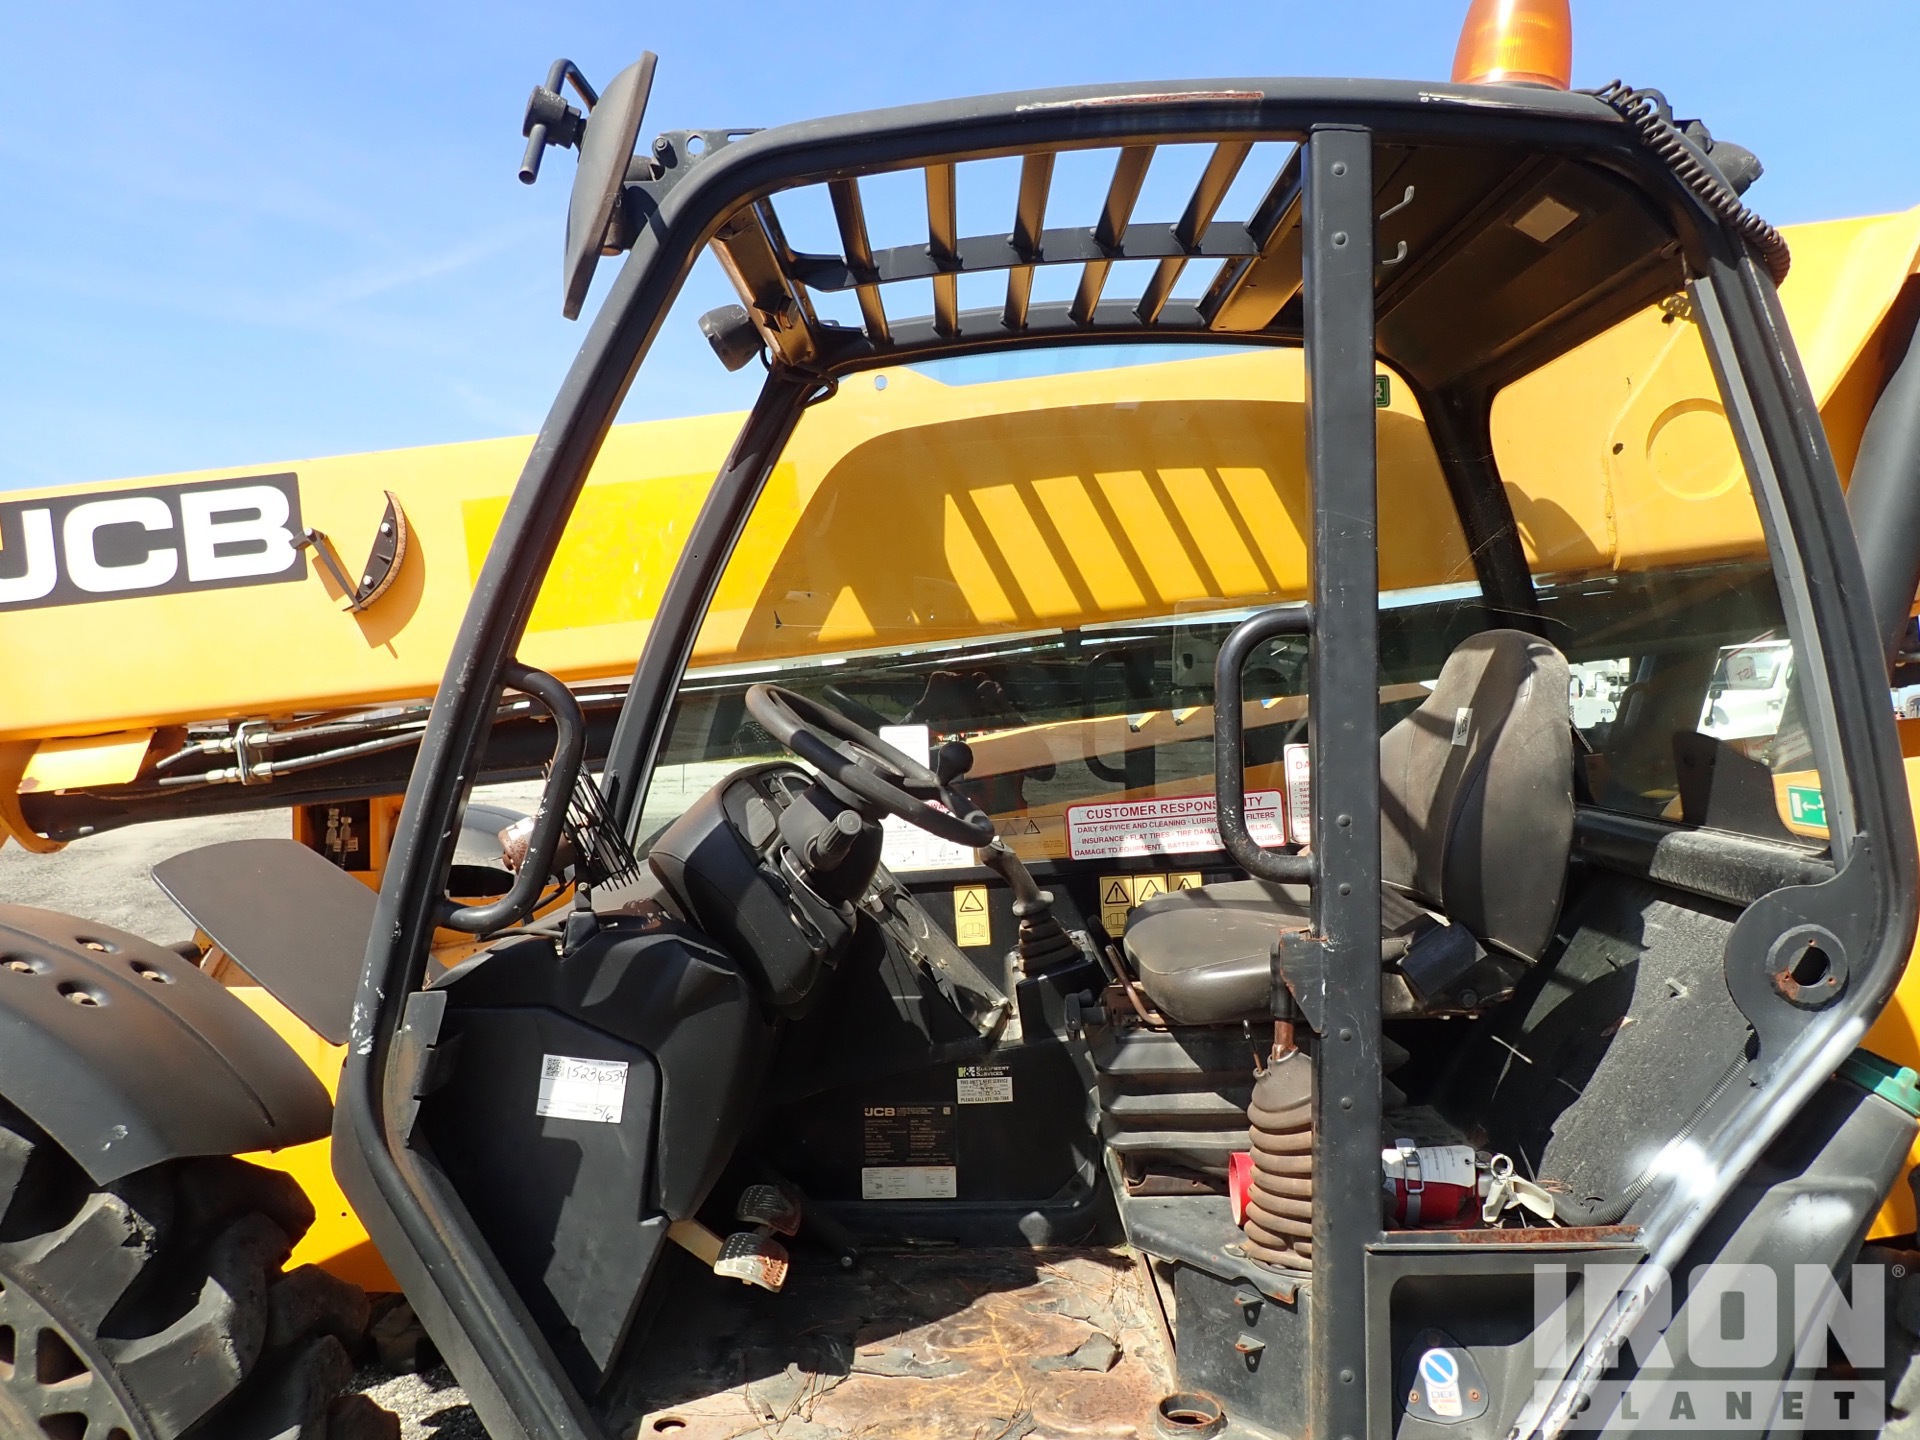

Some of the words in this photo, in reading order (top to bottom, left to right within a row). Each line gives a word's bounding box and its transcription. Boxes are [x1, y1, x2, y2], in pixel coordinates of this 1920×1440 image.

[0, 485, 297, 603] JCB
[1086, 805, 1157, 820] CUSTOMER
[1077, 824, 1098, 834] DAILY
[1099, 823, 1131, 832] SERVICE
[1132, 821, 1148, 829] AND
[1149, 819, 1187, 828] CLEANING
[1246, 812, 1275, 820] FILTERS
[1075, 847, 1106, 857] DAMAGE
[1119, 844, 1162, 853] EQUIPMENT
[1167, 841, 1199, 849] BATTERY
[1256, 834, 1283, 842] FLUIDS
[1081, 836, 1124, 845] INSURANCE
[1130, 833, 1147, 841] FLAT
[864, 1107, 896, 1117] JCB
